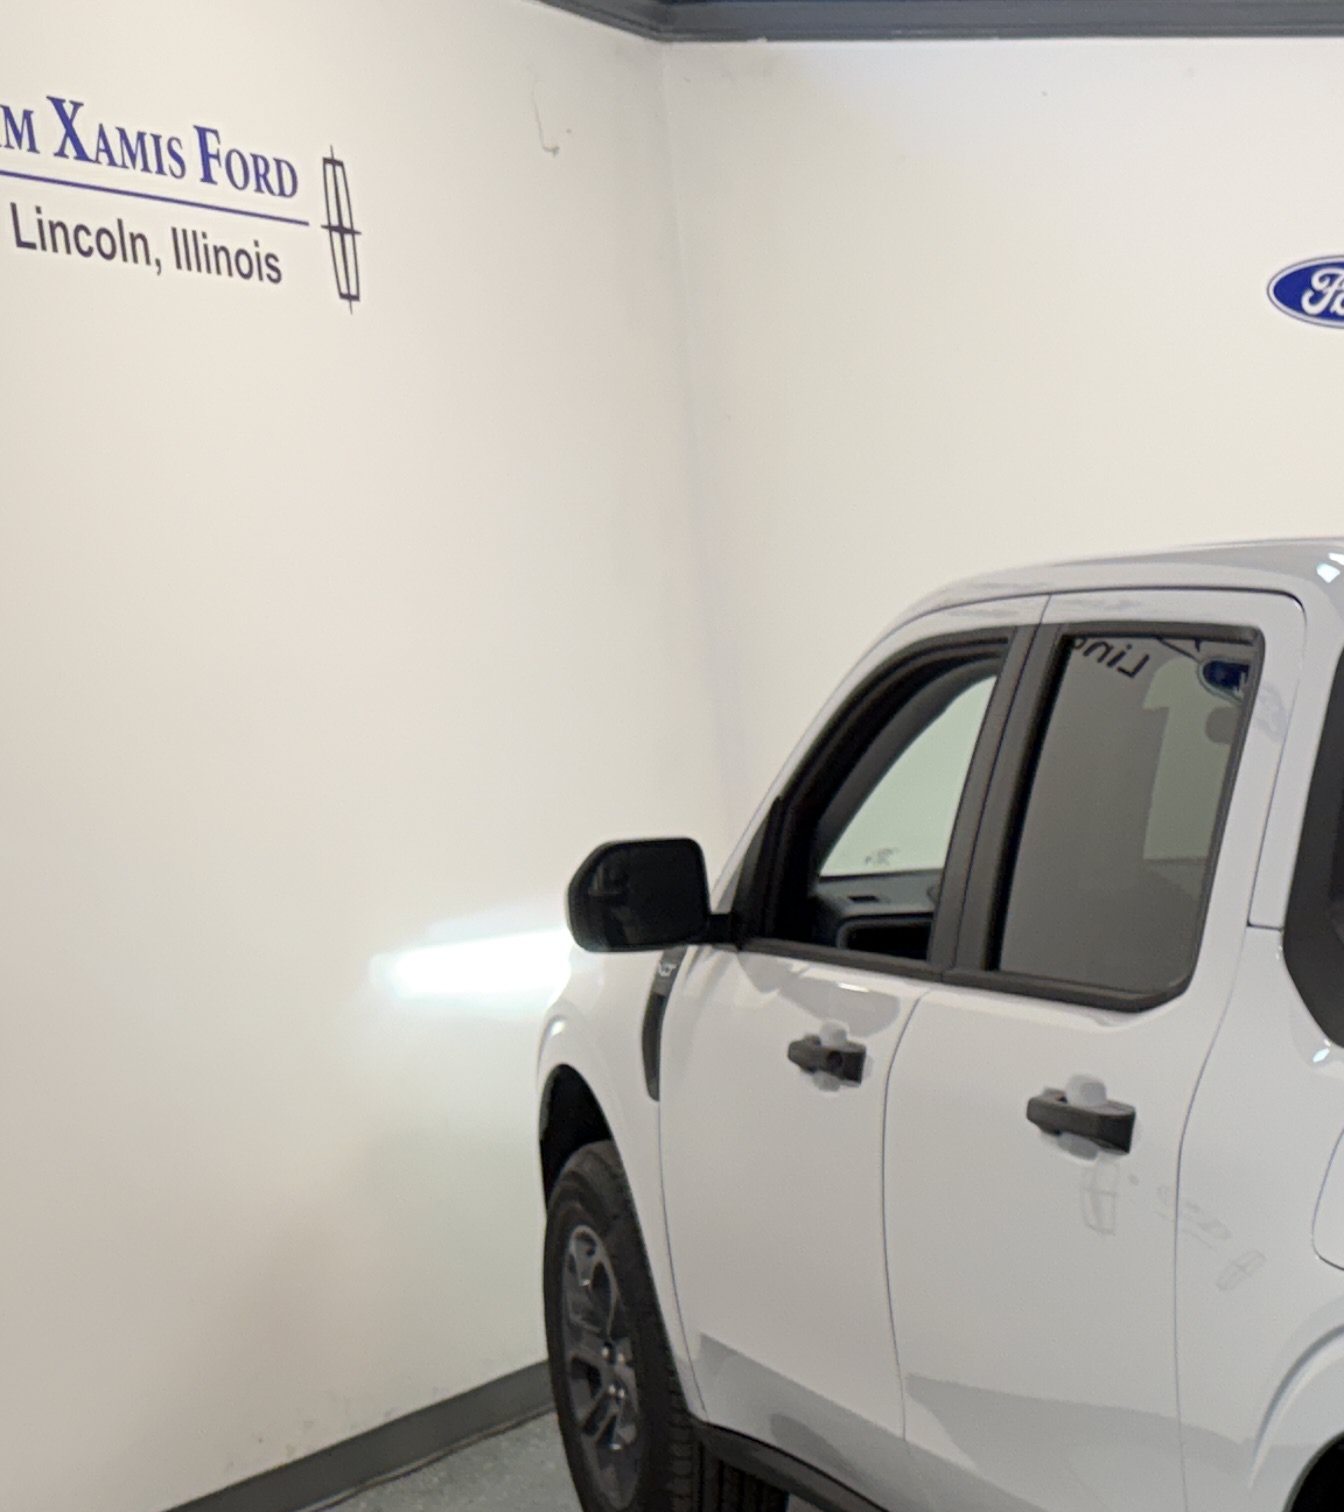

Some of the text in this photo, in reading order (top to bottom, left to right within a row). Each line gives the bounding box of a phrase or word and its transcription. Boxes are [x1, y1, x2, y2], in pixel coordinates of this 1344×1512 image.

[46, 95, 188, 180] XAMIS
[193, 124, 300, 199] FORD
[10, 201, 283, 285] Lincoln, Illinois
